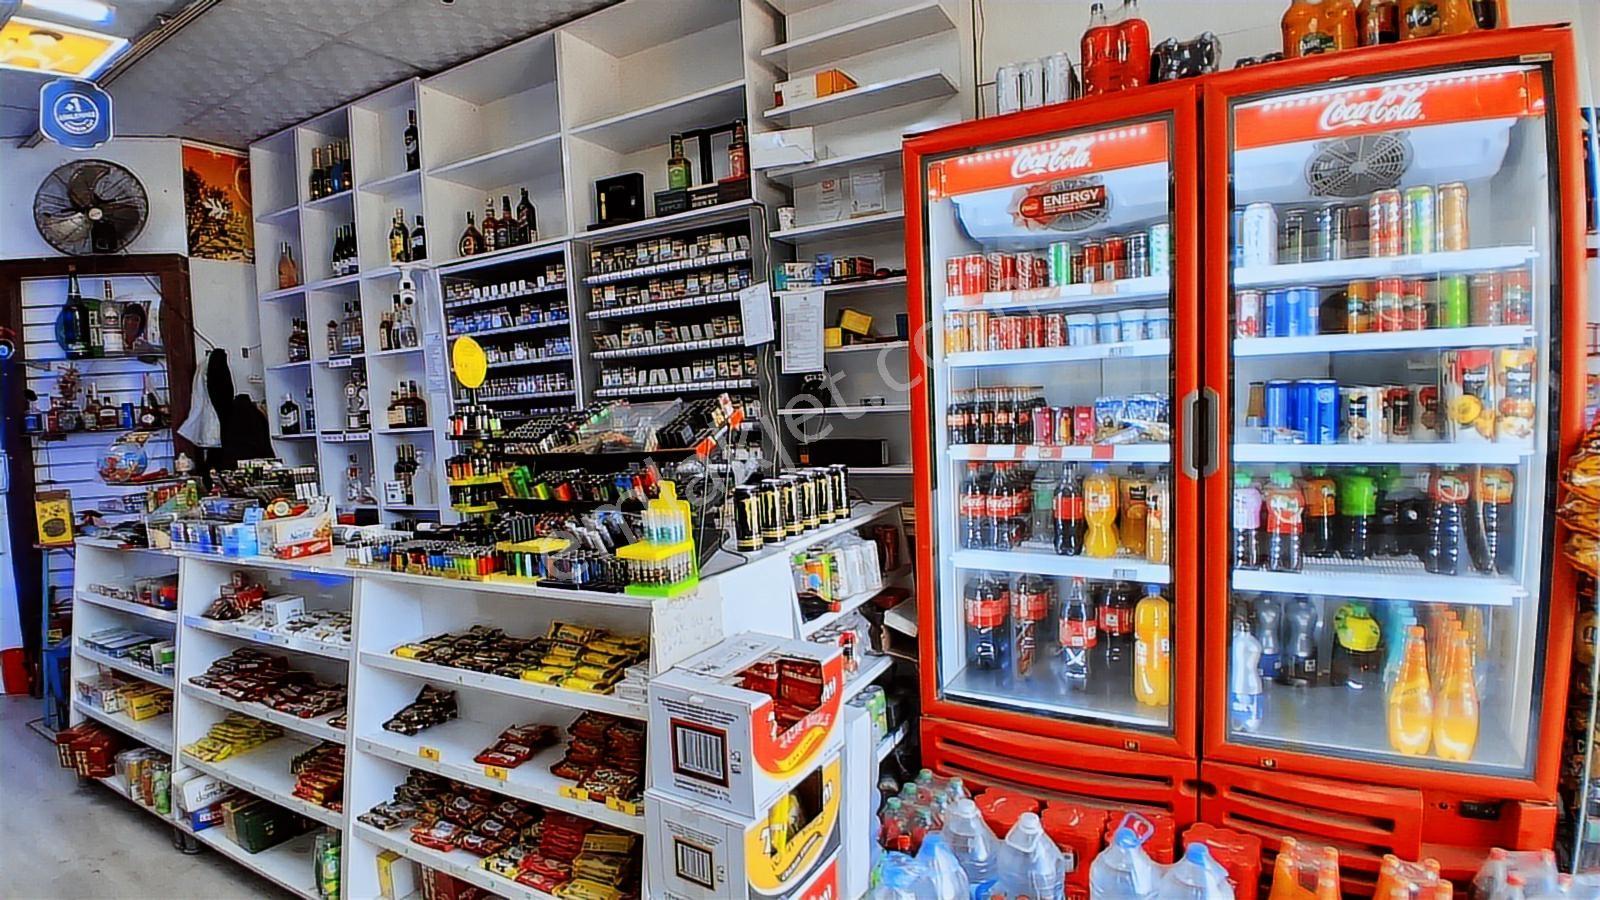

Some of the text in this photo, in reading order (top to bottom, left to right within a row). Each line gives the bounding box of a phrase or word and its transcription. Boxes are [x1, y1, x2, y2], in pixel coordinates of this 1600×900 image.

[1321, 85, 1427, 130] Coca-Cola
[1011, 137, 1095, 178] Coca-Cola
[1042, 187, 1100, 208] ENERGY
